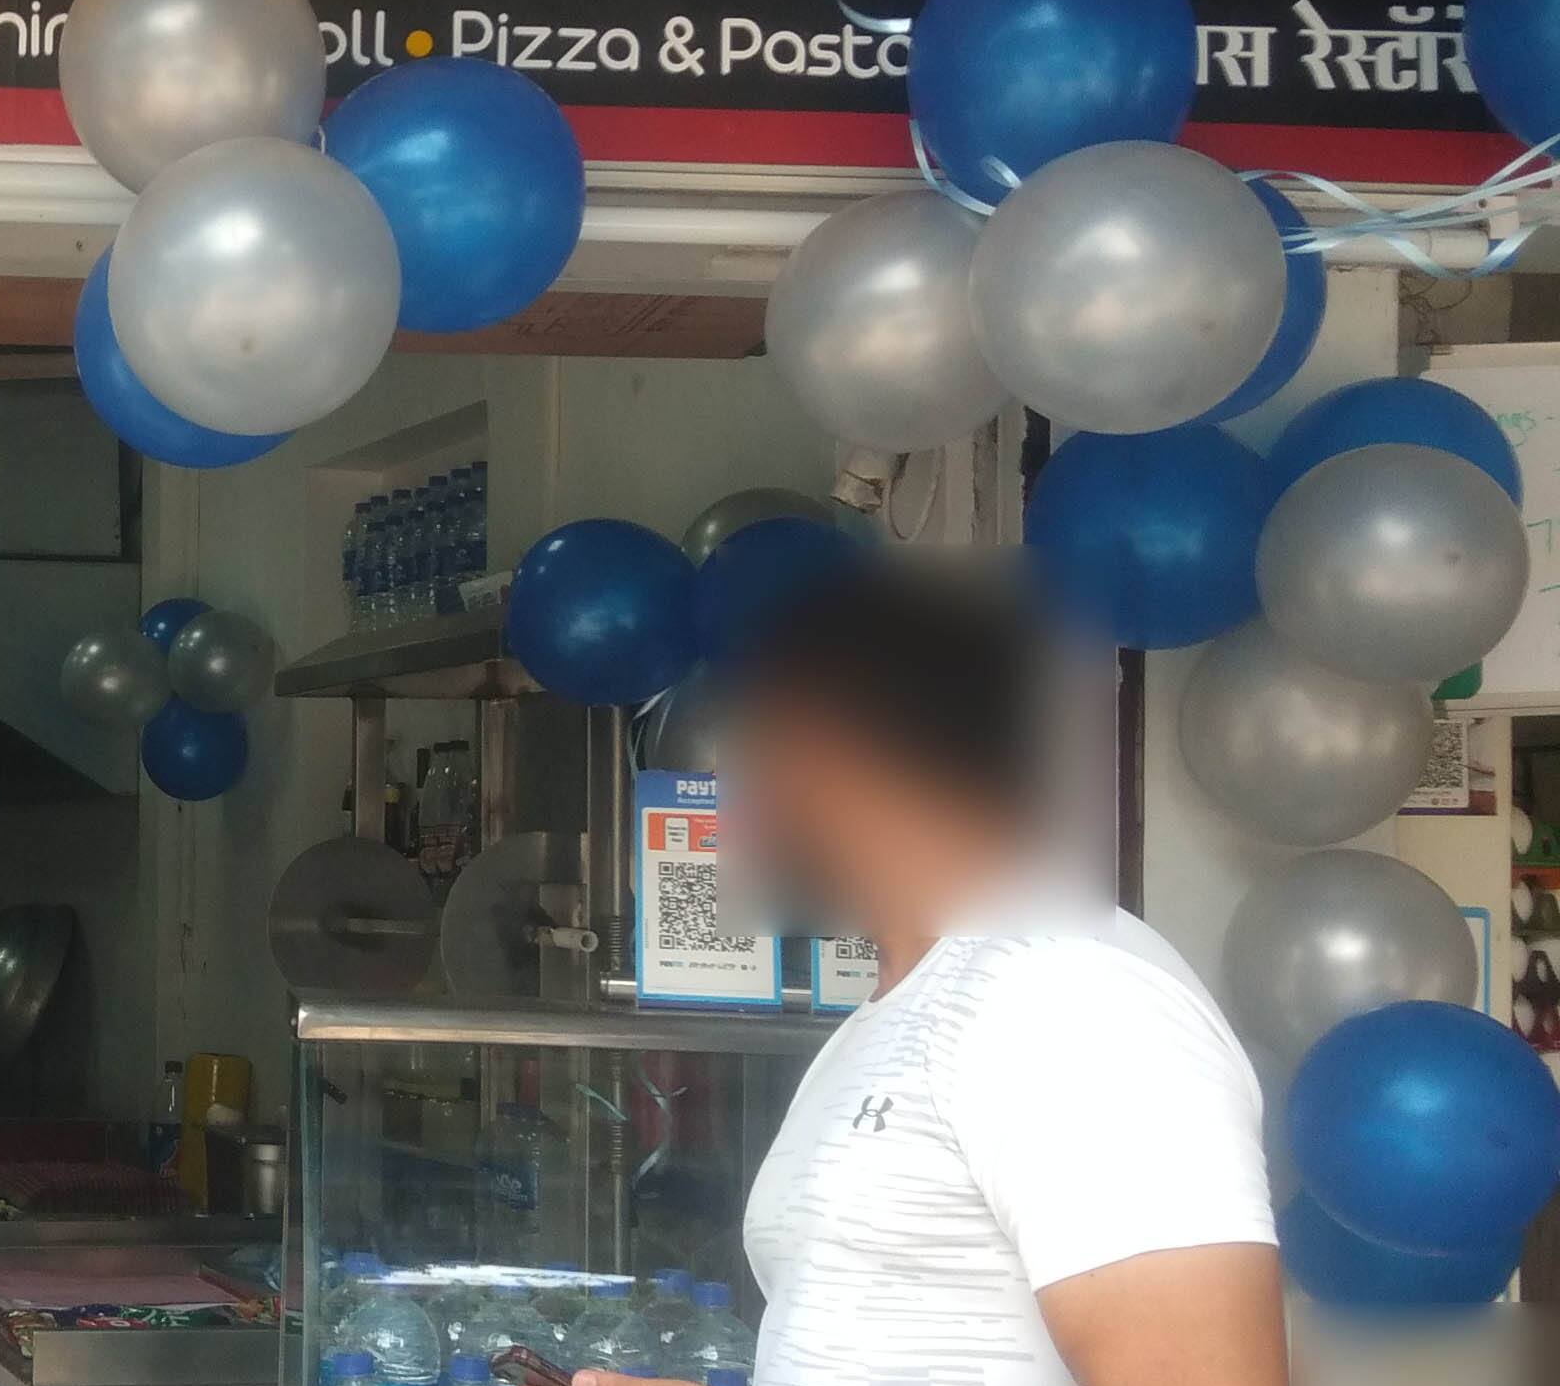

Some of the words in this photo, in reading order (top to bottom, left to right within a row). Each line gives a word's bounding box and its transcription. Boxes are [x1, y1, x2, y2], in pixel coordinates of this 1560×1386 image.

[317, 8, 394, 67] oll
[451, 9, 640, 73] Pizza
[658, 15, 706, 77] &
